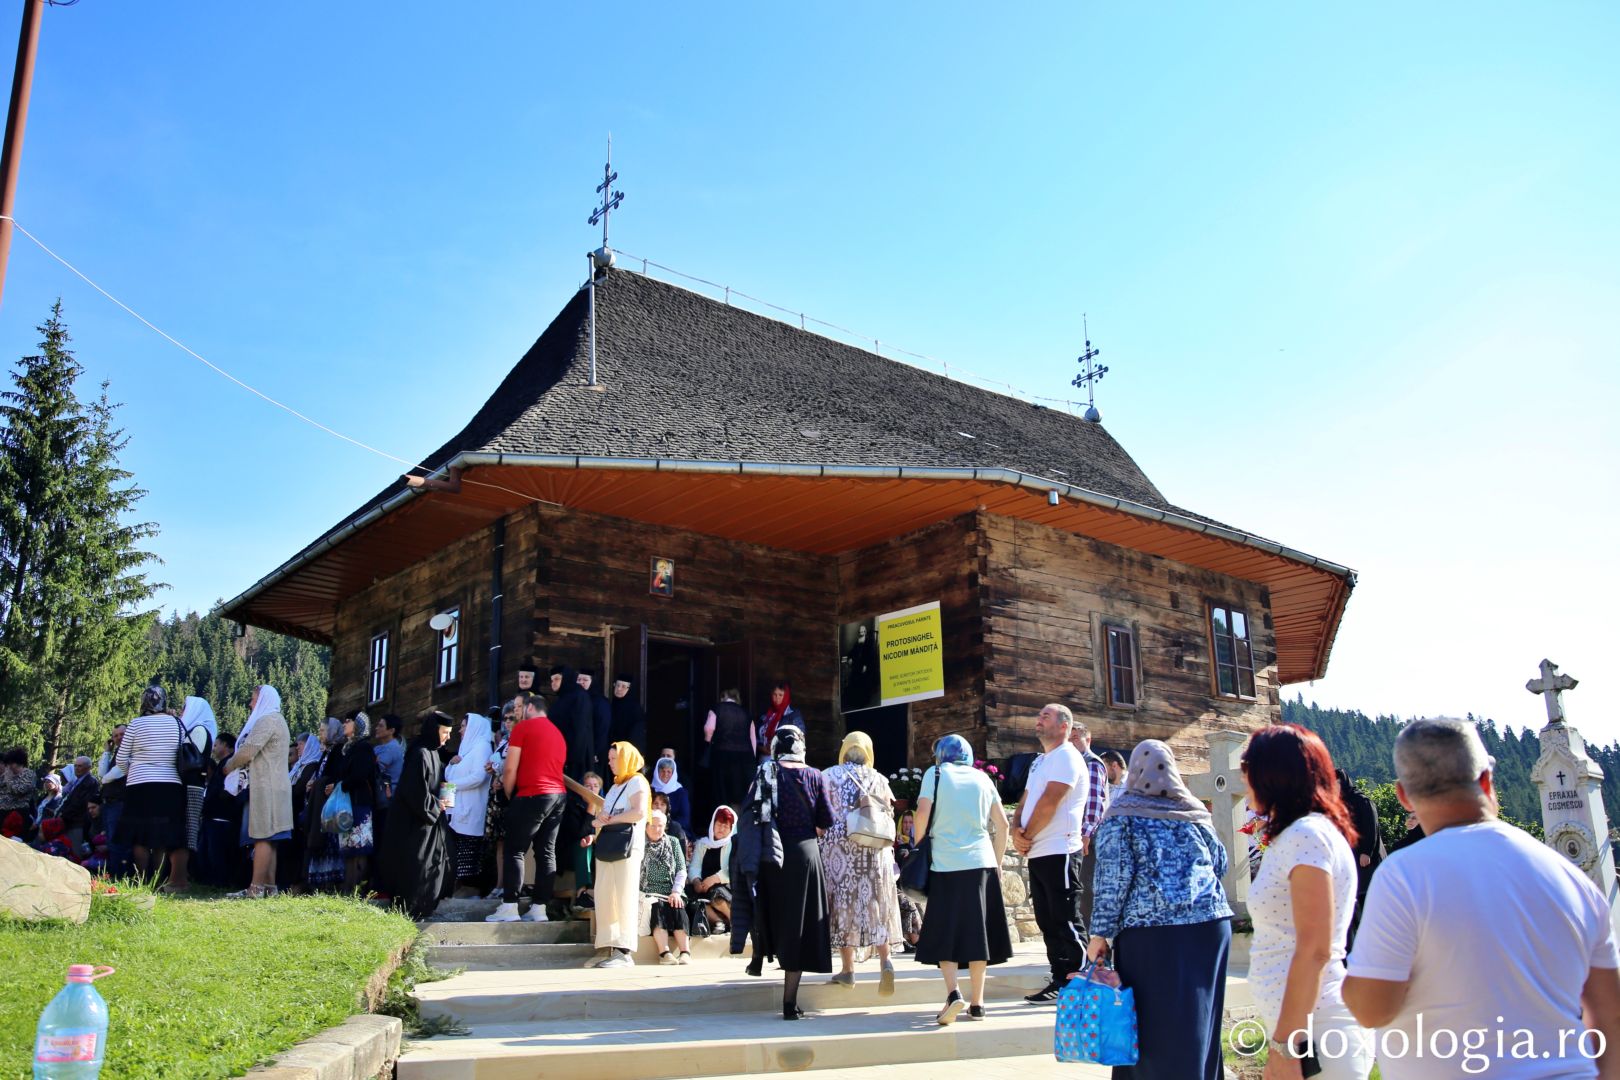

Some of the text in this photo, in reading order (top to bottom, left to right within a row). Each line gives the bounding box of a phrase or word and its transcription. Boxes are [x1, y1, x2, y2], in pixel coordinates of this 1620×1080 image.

[886, 632, 934, 648] PROTOSINGHEL
[883, 649, 909, 661] NICODIM
[1548, 800, 1583, 811] COSMESCU
